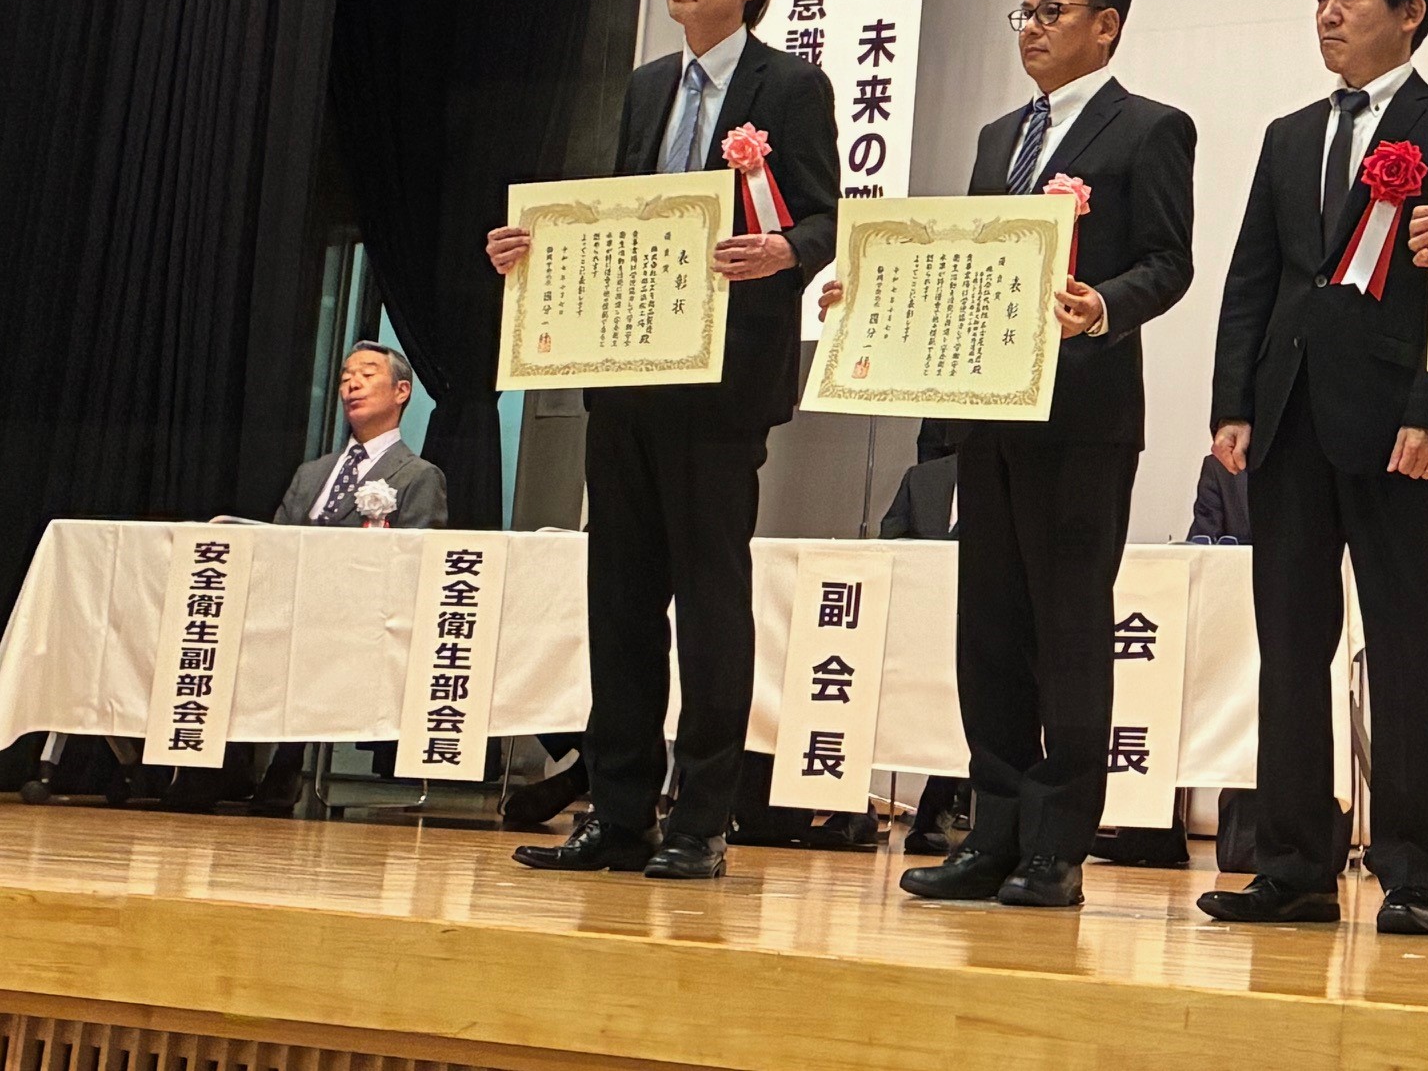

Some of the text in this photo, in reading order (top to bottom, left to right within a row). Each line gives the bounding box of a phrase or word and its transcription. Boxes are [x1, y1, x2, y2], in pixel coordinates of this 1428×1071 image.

[671, 249, 690, 315] 表彰状
[1002, 275, 1022, 346] 表彰状
[167, 540, 231, 753] 安全衛生副部会長
[421, 548, 484, 766] 安全衛生部会長
[801, 580, 863, 780] 副会長
